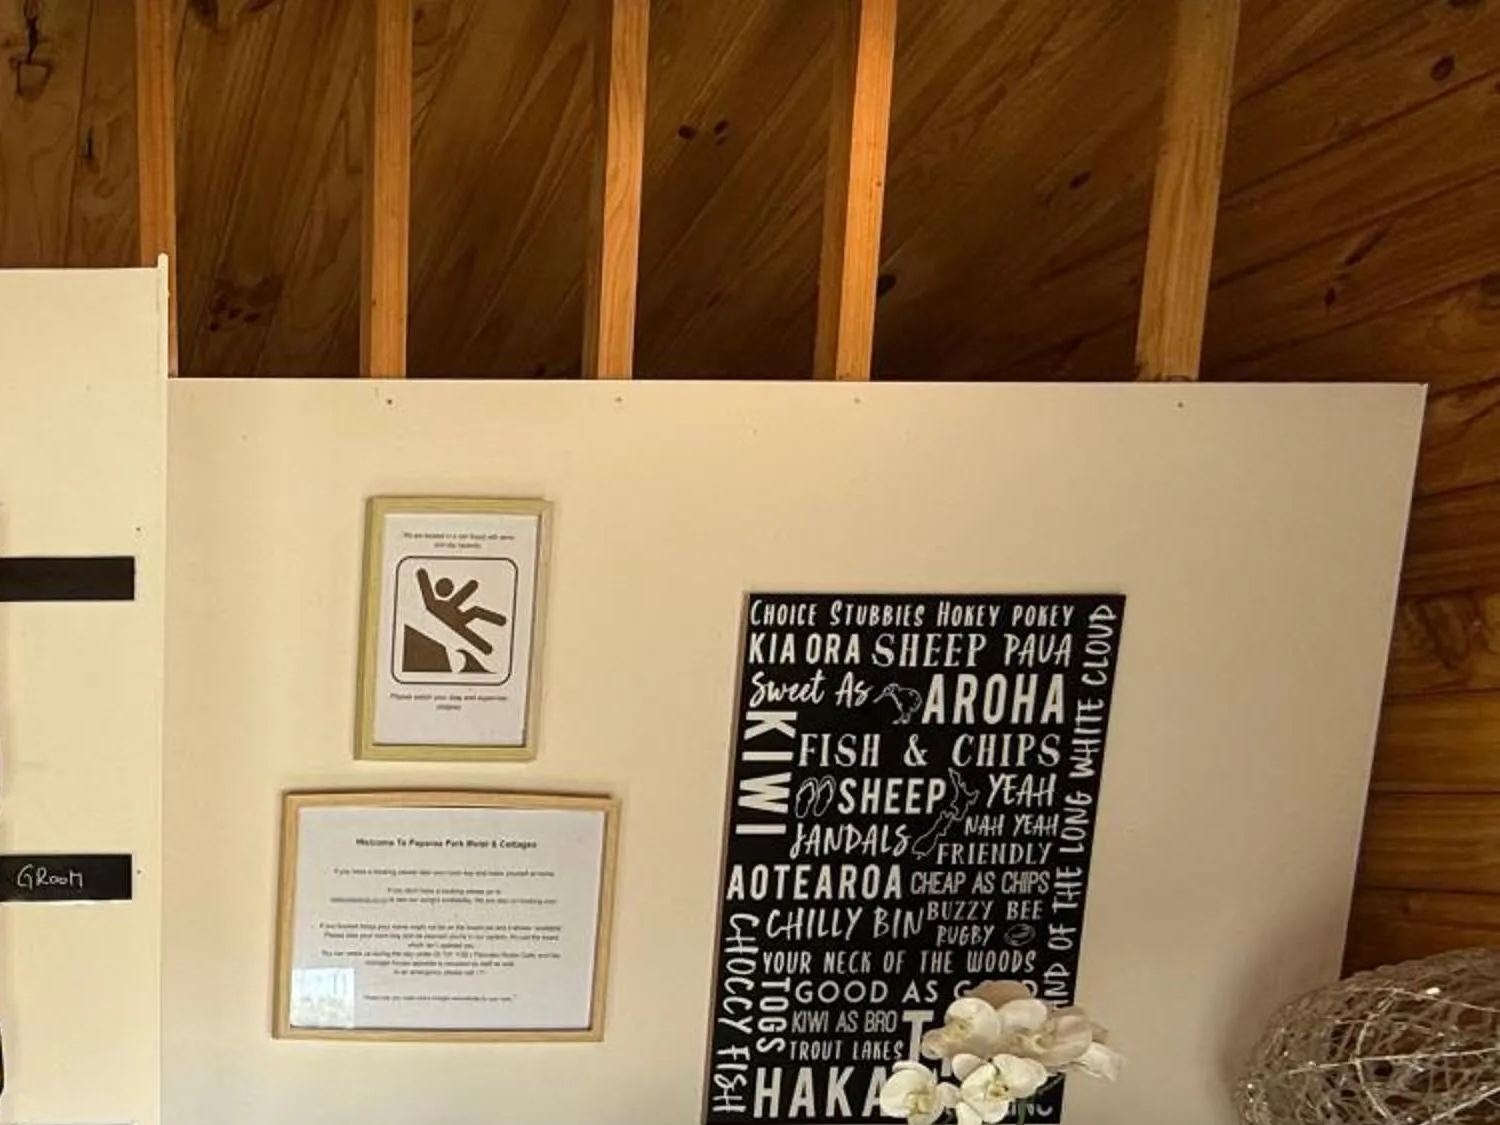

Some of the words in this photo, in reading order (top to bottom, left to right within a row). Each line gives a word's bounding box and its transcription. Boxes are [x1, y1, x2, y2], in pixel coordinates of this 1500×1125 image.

[751, 600, 817, 626] CHOICE
[830, 600, 924, 626] STUBBIES
[937, 602, 1000, 626] HOKEY
[1012, 606, 1073, 626] POKEY
[749, 633, 795, 663] KIA
[806, 633, 859, 664] ORA
[872, 634, 986, 666] SHEEP
[1004, 634, 1071, 666] PAUA
[1081, 604, 1117, 685] CLOUD
[750, 669, 824, 707] Sweet
[836, 672, 871, 707] As
[922, 674, 1063, 724] AROHA
[801, 734, 880, 766] FISH
[904, 734, 926, 766] &
[953, 734, 1059, 766] CHIPS
[1068, 698, 1105, 778] WHITE
[736, 711, 798, 834] KIWI
[838, 778, 945, 814] SHEEP
[987, 774, 1056, 807] YEAH
[966, 815, 1004, 836] NAH
[1014, 814, 1059, 836] YEAH
[1058, 791, 1093, 853] LONG
[790, 823, 909, 859] JANDALS
[938, 843, 1051, 864] FRIENDLY
[16, 863, 84, 890] GROOM
[727, 864, 901, 900] AOTEAROA
[912, 872, 965, 893] CHEAP
[972, 872, 994, 893] AS
[1002, 872, 1049, 893] CHIPS
[1051, 866, 1084, 914] THE
[767, 907, 862, 940] CHILLY
[874, 907, 924, 937] BIN
[928, 902, 992, 920] BUZZY
[1007, 901, 1044, 919] BEE
[938, 926, 994, 945] RUGBY
[1047, 923, 1078, 951] OF
[718, 913, 760, 1034] CHOCCY
[764, 952, 811, 973] YOUR
[824, 952, 870, 974] NECK
[884, 952, 904, 972] OF
[919, 952, 952, 972] THE
[968, 951, 1035, 972] WOODS
[796, 981, 887, 1003] GOOD
[903, 981, 937, 1002] AS
[756, 977, 790, 1052] TOGS
[792, 1012, 828, 1032] KIWI
[836, 1011, 858, 1032] AS
[865, 1011, 896, 1032] BRO
[789, 1040, 843, 1059] TROUT
[852, 1039, 904, 1060] LAKES
[713, 1046, 750, 1112] FISH
